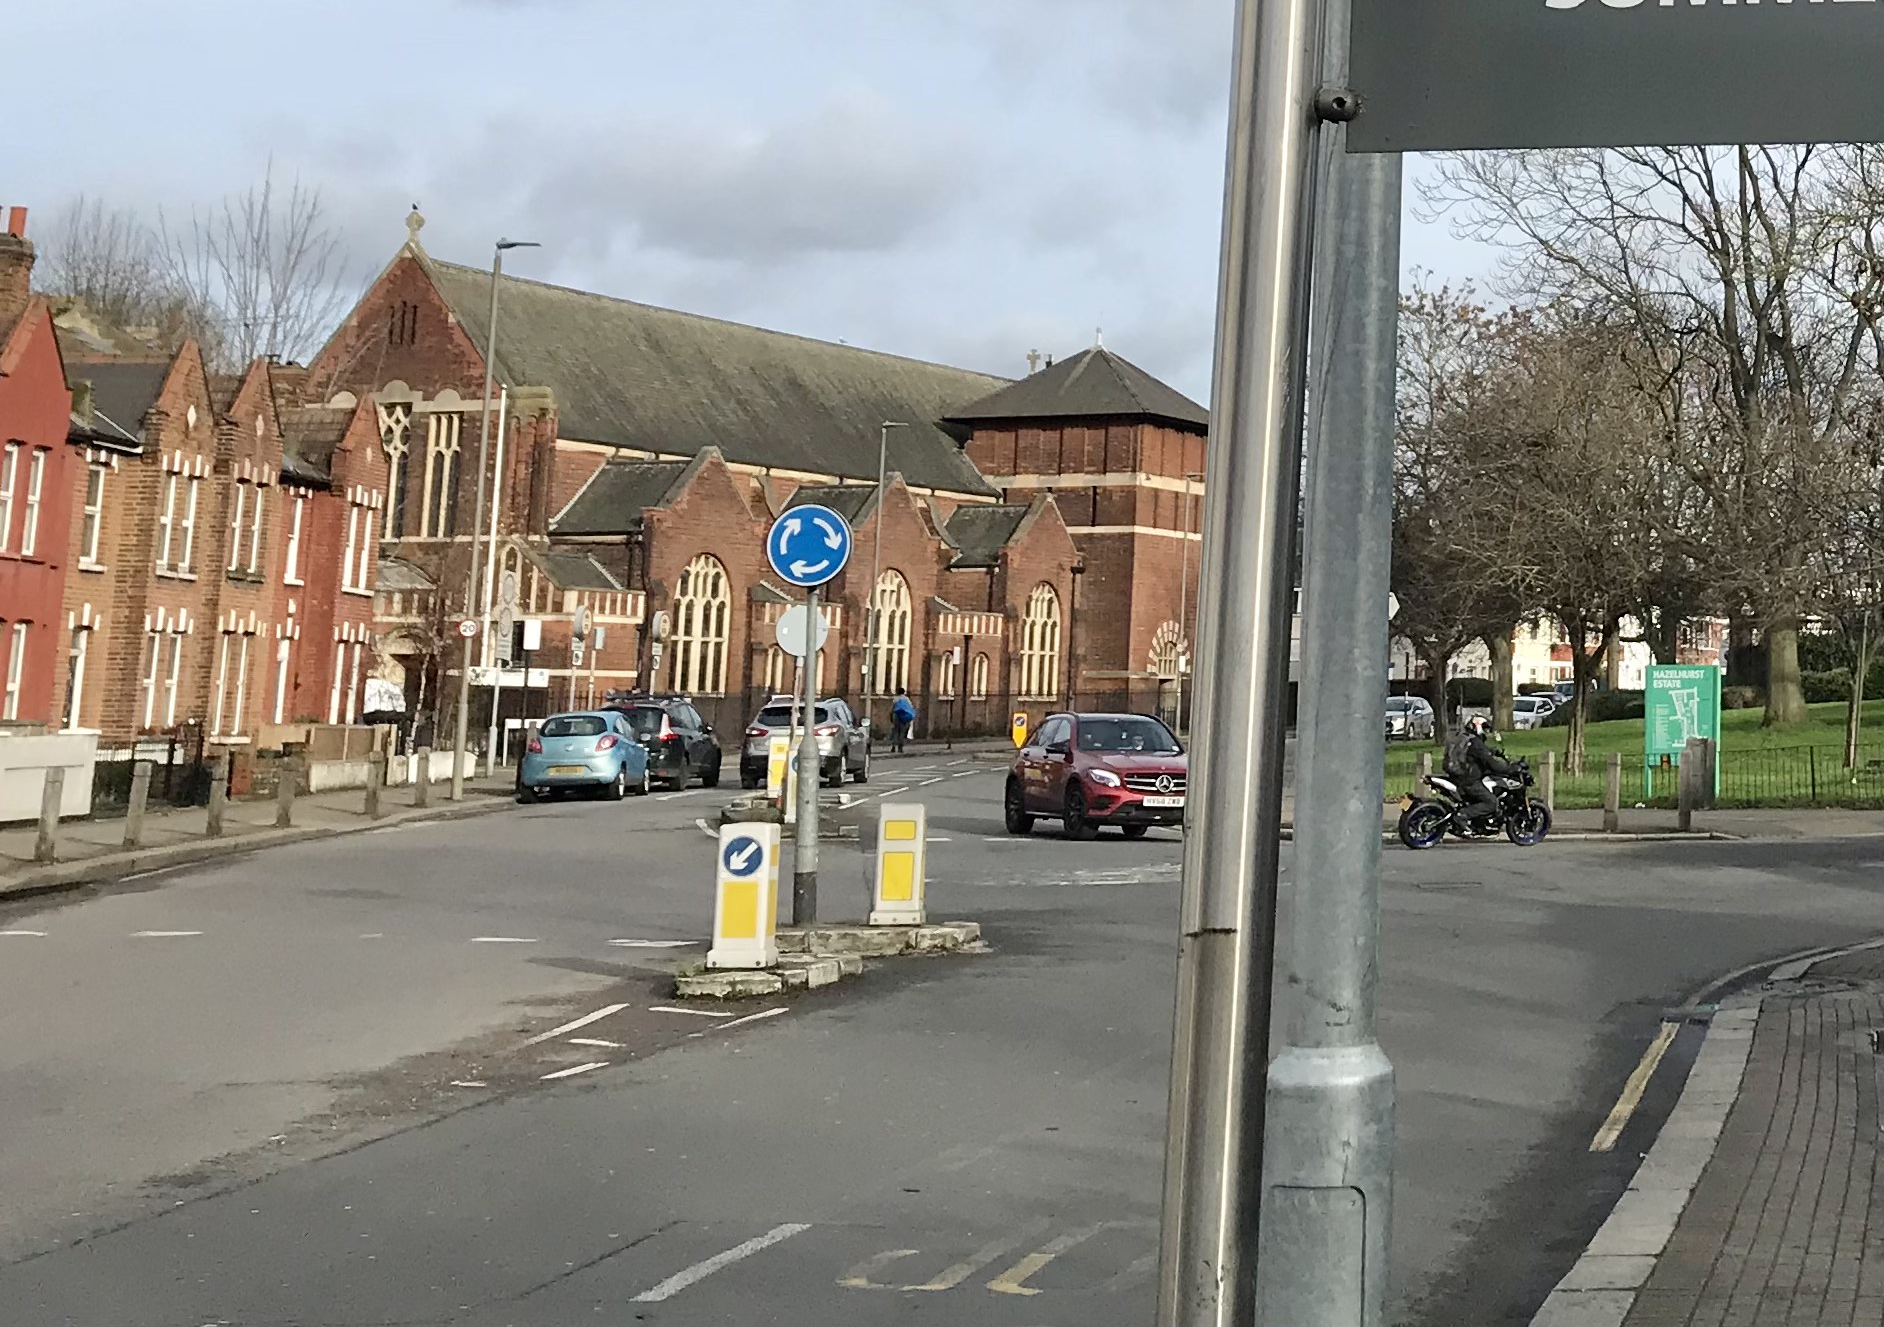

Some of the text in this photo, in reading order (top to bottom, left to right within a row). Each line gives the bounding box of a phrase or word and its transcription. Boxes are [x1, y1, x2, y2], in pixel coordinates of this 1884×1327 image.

[462, 624, 475, 633] 20
[1653, 670, 1705, 679] HAZELHURST
[1653, 680, 1682, 688] ESTATE
